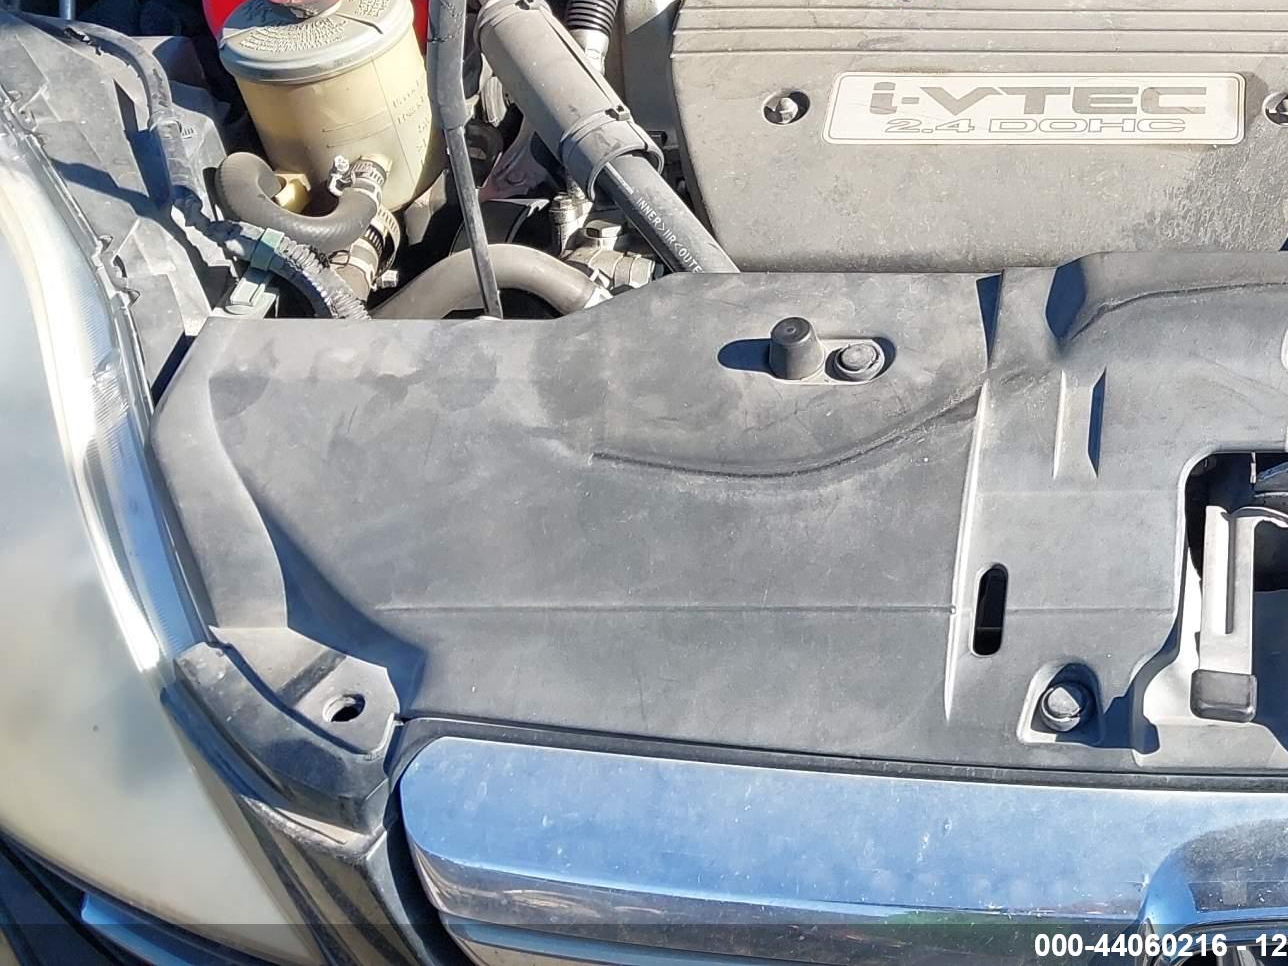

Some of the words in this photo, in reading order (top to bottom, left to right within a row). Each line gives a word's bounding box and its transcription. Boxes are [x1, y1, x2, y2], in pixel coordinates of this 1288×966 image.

[869, 81, 1207, 116] i-VTEC
[884, 118, 976, 134] 2.4
[988, 118, 1186, 134] DOHC
